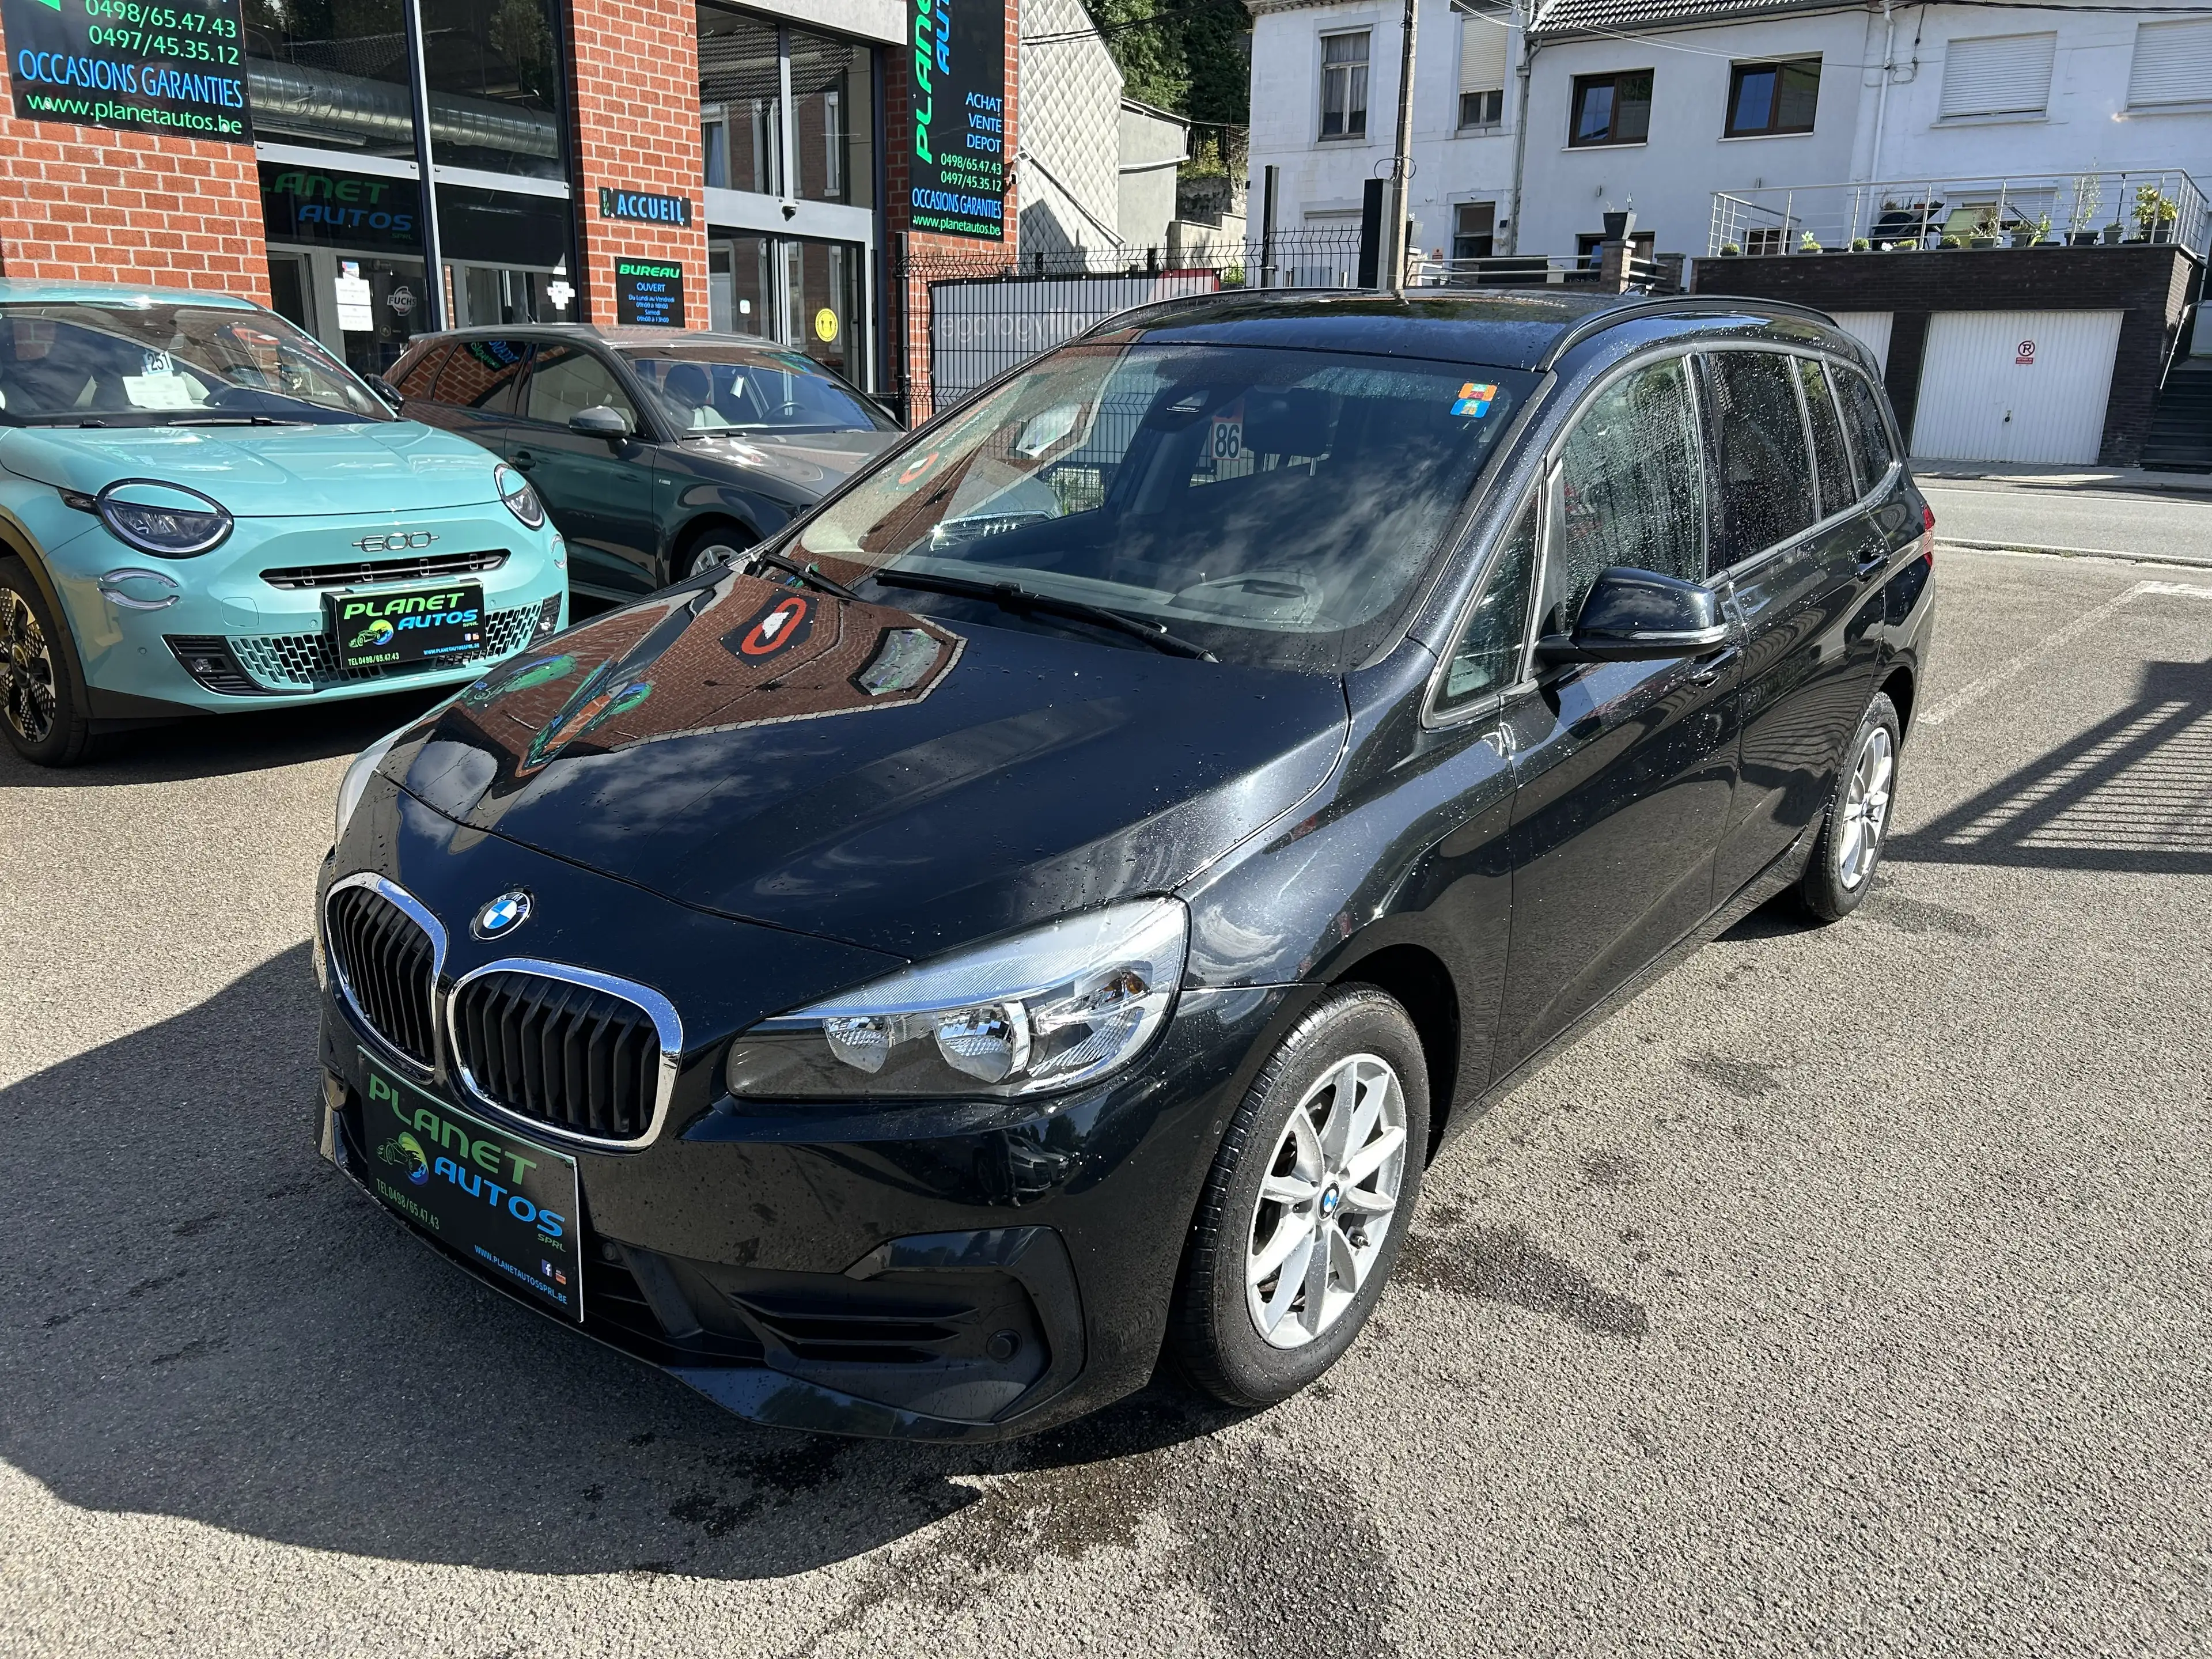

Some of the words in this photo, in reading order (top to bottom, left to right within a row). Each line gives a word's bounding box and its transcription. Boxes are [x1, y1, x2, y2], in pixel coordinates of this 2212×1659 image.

[86, 0, 237, 38] 0498/65.47.43
[89, 25, 240, 66] 0497/45.35.12
[18, 50, 137, 93] OCCASIONS
[142, 67, 243, 108] GARANTIES
[965, 92, 1002, 112] ACHAT
[26, 94, 243, 135] www.planetautos.be
[969, 113, 1002, 134] VENTE
[967, 134, 1002, 153] DEPOT
[940, 153, 1002, 175] 0498/65.47.43
[940, 171, 1002, 192] 0497/45.35.12
[617, 194, 685, 222] ACCUEIL
[912, 188, 959, 213] OCCASIONS
[960, 194, 1002, 219] GARANTIES
[298, 204, 413, 232] AUTOS
[912, 214, 1001, 236] www.planetautos.be
[619, 264, 680, 278] BUREAU
[637, 282, 665, 292] OUVERT
[388, 296, 416, 307] FUCHS
[148, 351, 170, 372] 251
[1215, 423, 1240, 458] 86
[343, 592, 465, 620] PLANET
[397, 609, 479, 630] AUTOS
[498, 893, 527, 914] BMW
[369, 1073, 537, 1185] PLANET
[434, 1157, 565, 1237] AUTOS
[537, 1233, 566, 1252] SPRL
[474, 1244, 568, 1305] WWW.PLANETAUTOSSPRL.BE
